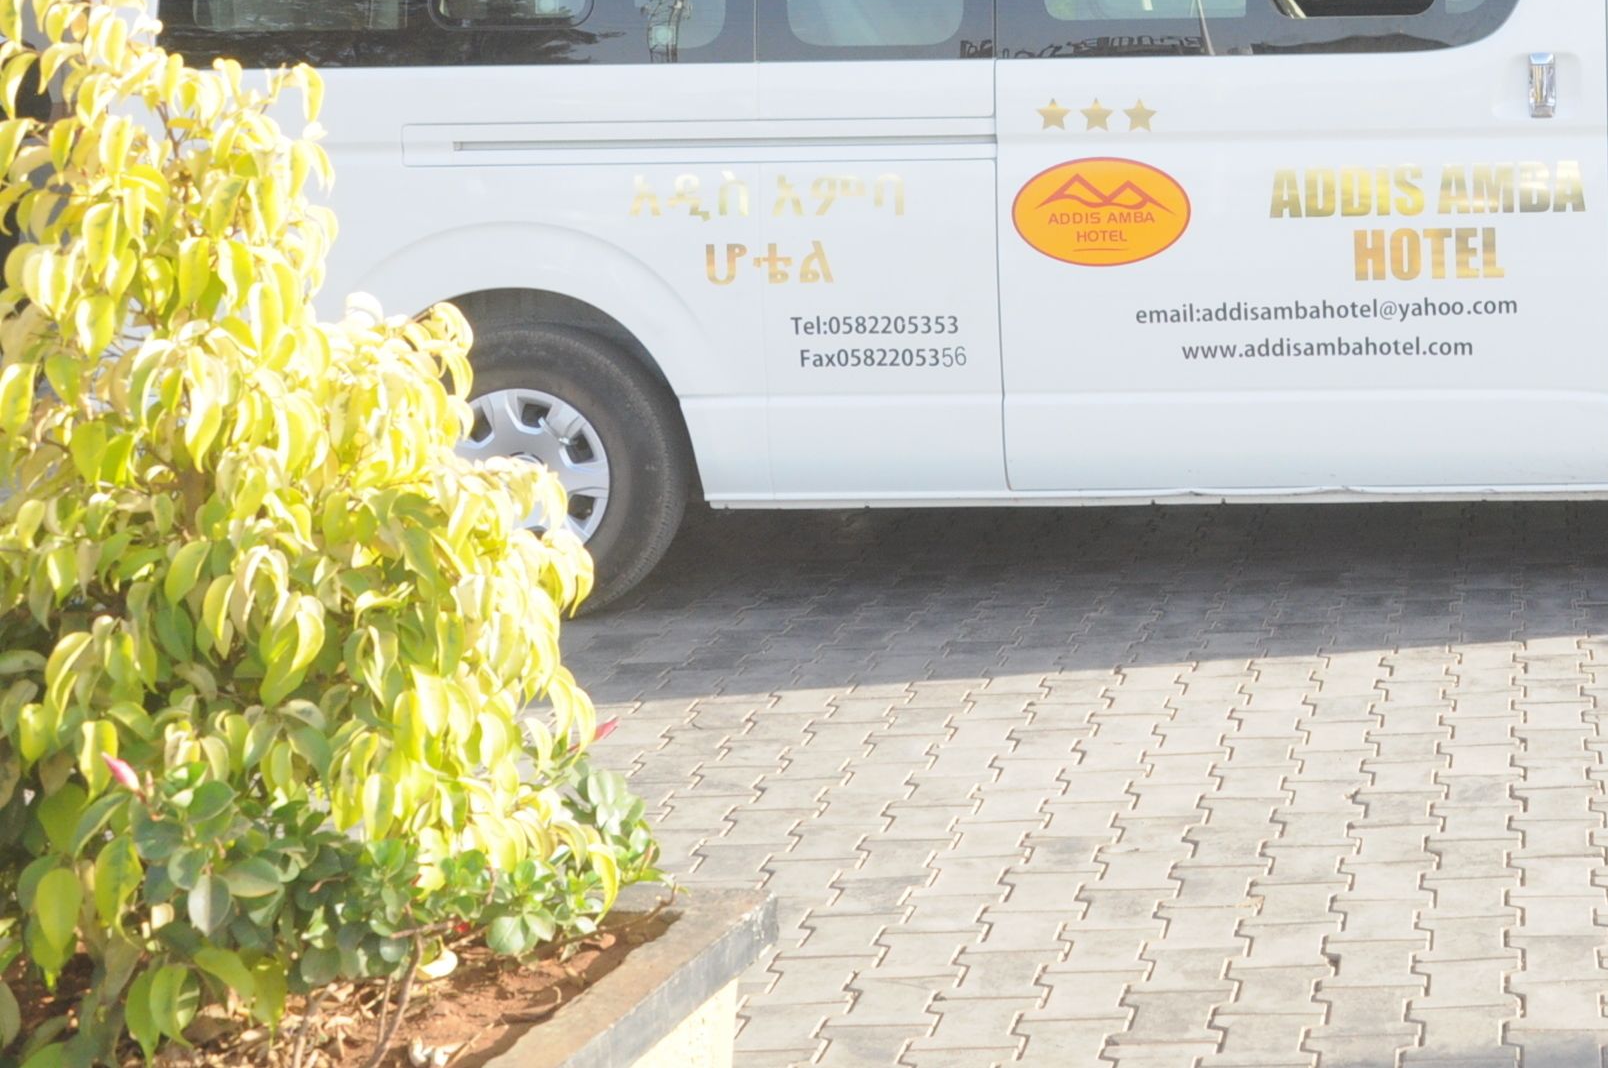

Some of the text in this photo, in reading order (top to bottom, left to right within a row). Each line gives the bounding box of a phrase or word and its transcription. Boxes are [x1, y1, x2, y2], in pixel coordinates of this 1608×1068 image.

[1268, 159, 1587, 219] ADDIS AMBA
[1047, 210, 1156, 226] ADDIS AMBA
[1075, 229, 1128, 243] HOTEL
[1353, 226, 1506, 282] HOTEL
[1135, 297, 1519, 325] email:addisambahotel@yahoo.com
[789, 315, 960, 336] Tel:0582205353
[799, 345, 968, 368] Fax0582205356
[1181, 335, 1474, 360] www.addisambahotel.com
